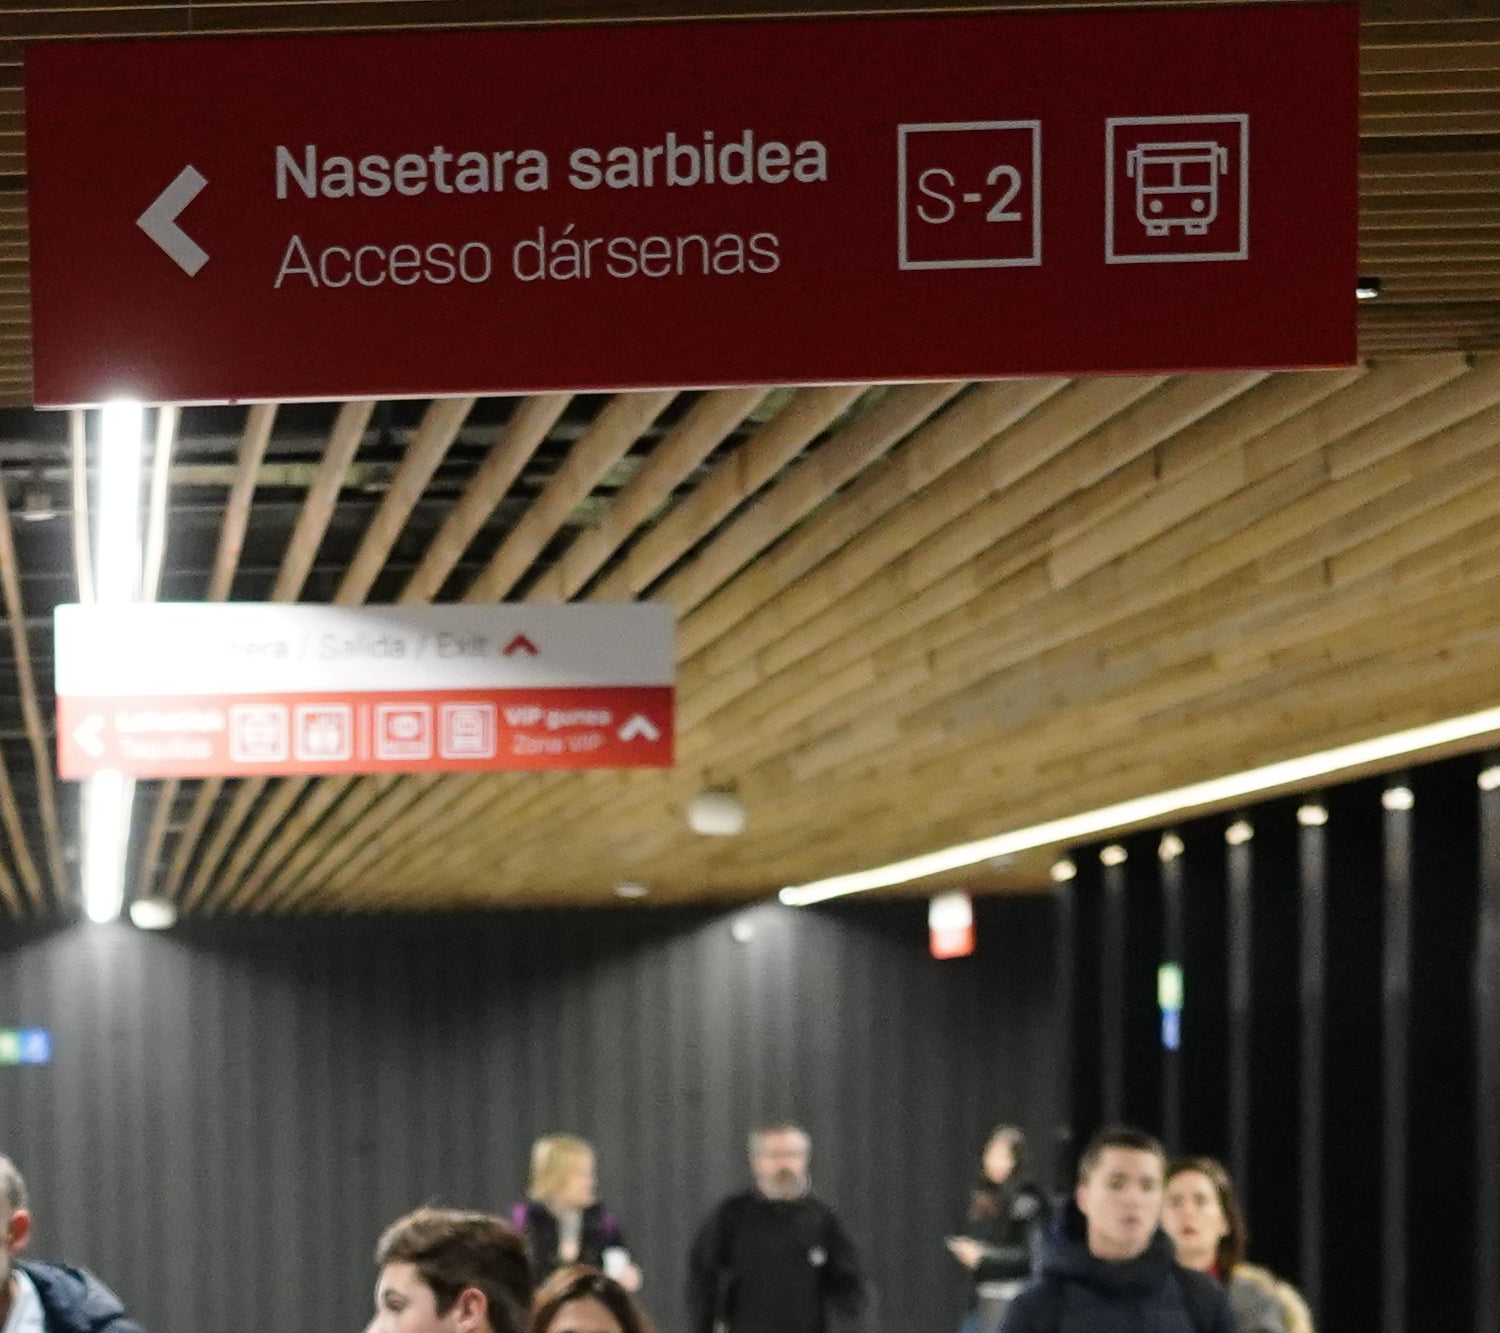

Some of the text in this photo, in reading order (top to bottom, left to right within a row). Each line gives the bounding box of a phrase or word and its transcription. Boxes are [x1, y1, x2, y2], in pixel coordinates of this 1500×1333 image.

[274, 128, 829, 200] Nasetara sarbidea
[916, 163, 1023, 225] S-2
[272, 222, 782, 290] Acceso dársenas
